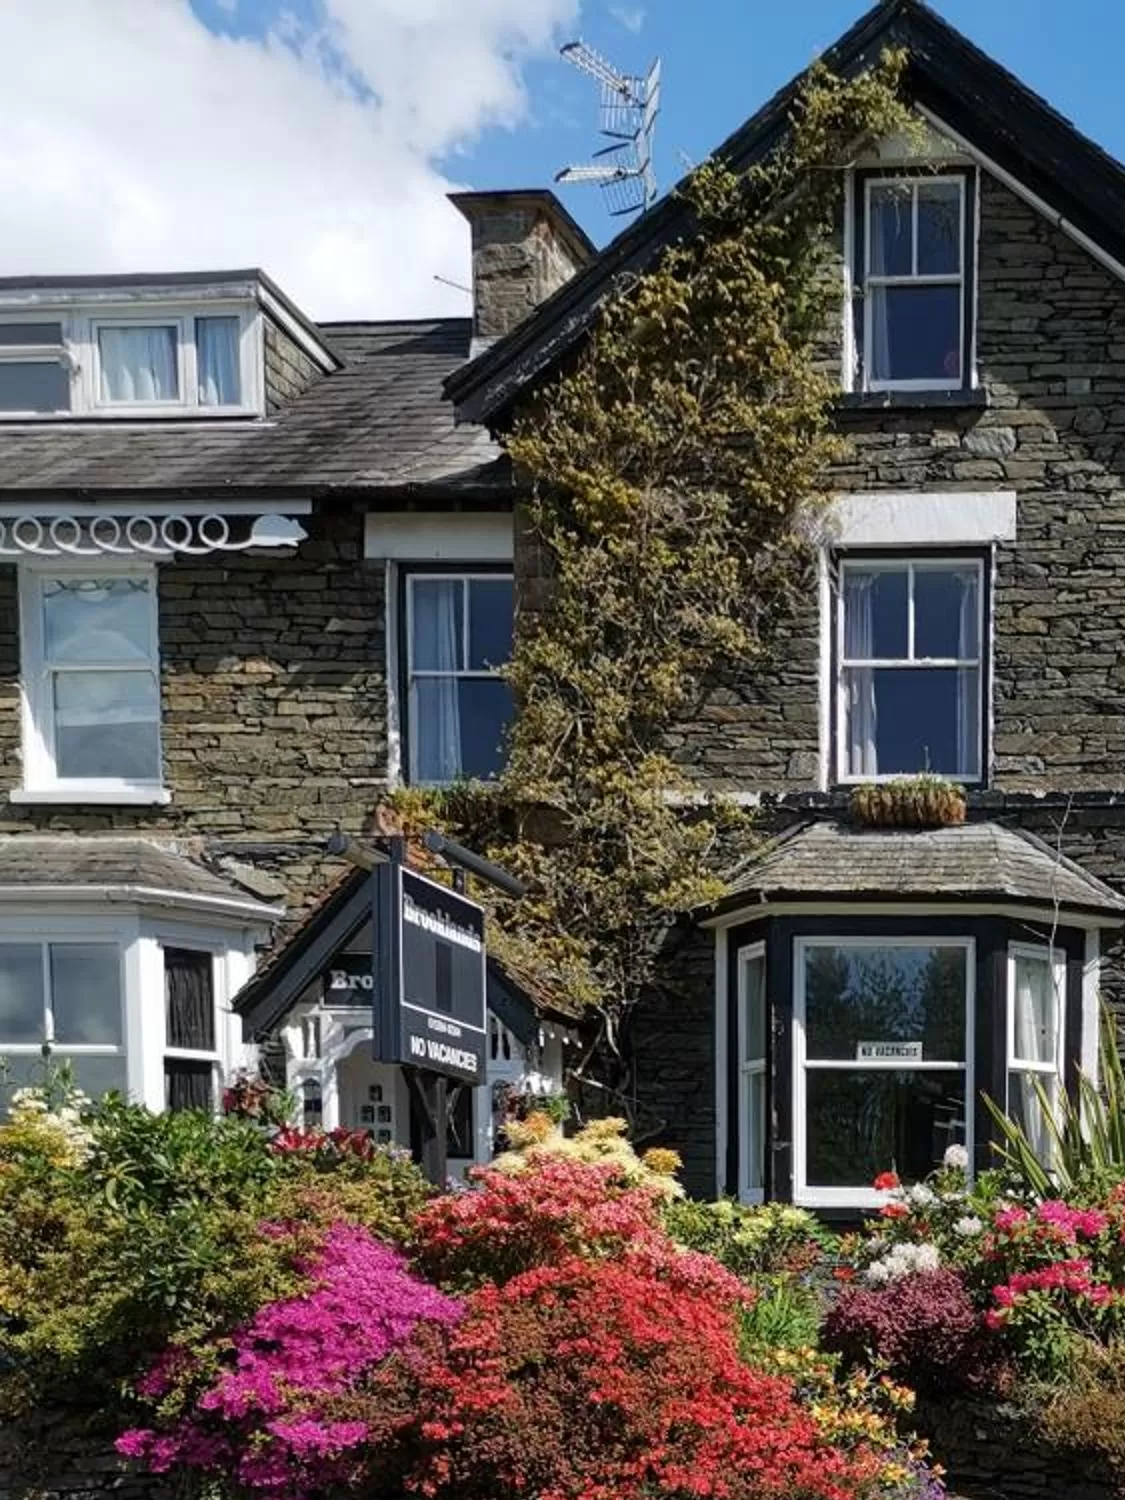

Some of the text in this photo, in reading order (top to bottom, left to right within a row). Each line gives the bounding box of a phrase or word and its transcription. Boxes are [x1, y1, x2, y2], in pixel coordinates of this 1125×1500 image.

[411, 1035, 477, 1073] NO VACANCIES
[861, 1046, 872, 1057] NO
